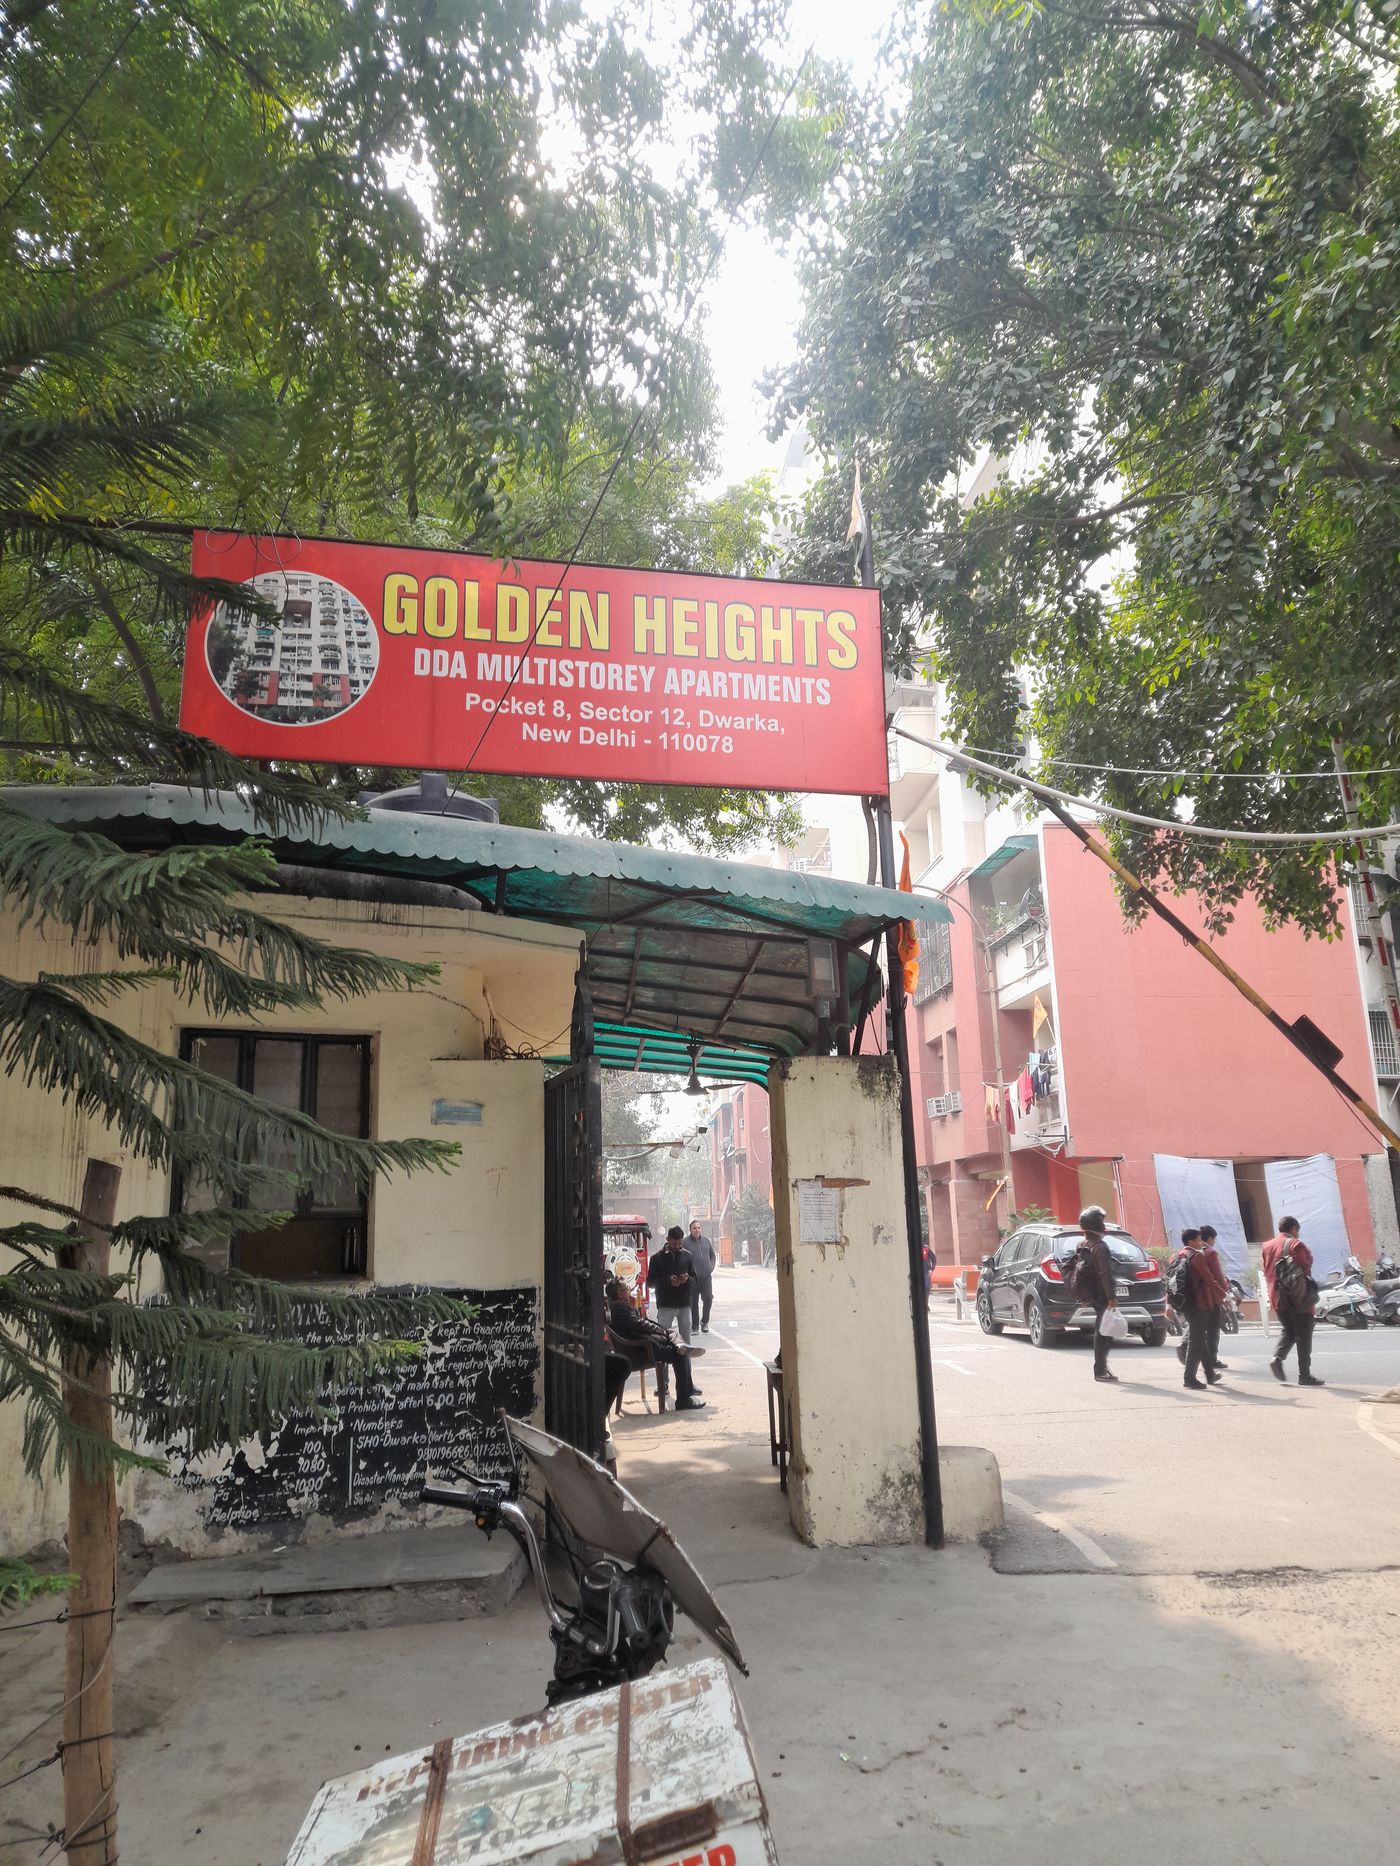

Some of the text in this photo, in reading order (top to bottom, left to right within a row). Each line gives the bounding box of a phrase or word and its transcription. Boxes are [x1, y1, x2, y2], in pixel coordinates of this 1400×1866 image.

[382, 572, 860, 670] GOLDEN HEIGHTS
[413, 647, 832, 706] DDA MULTISTOREY APARTMENTS
[465, 692, 786, 736] Pocket 8, Sector 12, Dwarka,
[521, 721, 572, 746] New
[578, 725, 638, 749] Delhi
[657, 730, 735, 755] 110078
[437, 1323, 460, 1339] kept
[462, 1326, 471, 1336] in
[473, 1322, 502, 1336] Guard
[406, 1381, 431, 1391] main
[302, 1440, 322, 1455] 100
